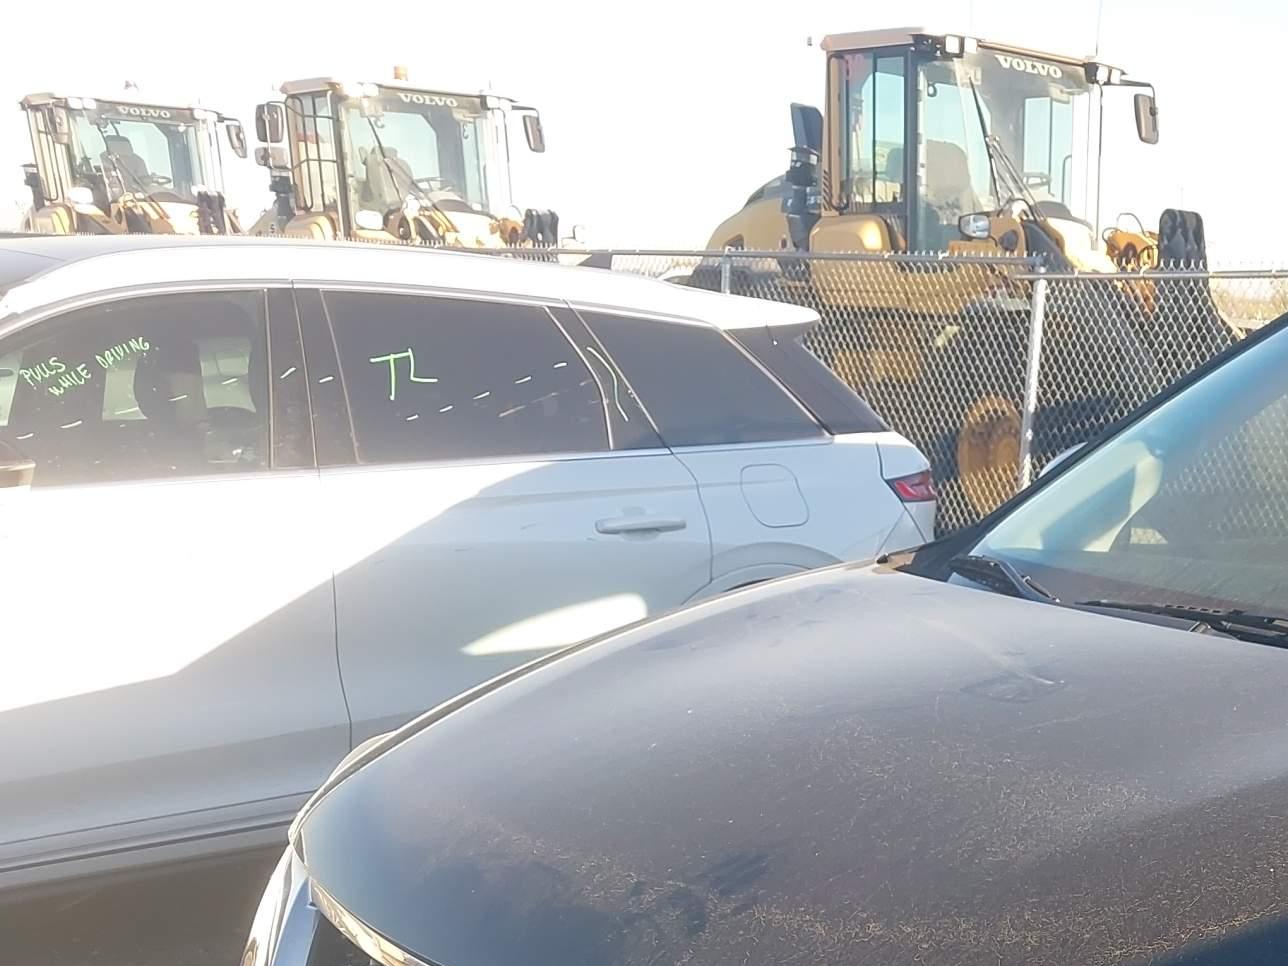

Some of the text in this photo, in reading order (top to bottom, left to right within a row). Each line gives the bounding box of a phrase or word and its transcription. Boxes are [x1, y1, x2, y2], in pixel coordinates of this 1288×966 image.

[994, 54, 1062, 78] VOLVO
[117, 105, 170, 118] VOLVO
[398, 93, 458, 107] VOLVO
[19, 356, 66, 387] PULLS
[48, 336, 150, 397] WHILE DRIVING
